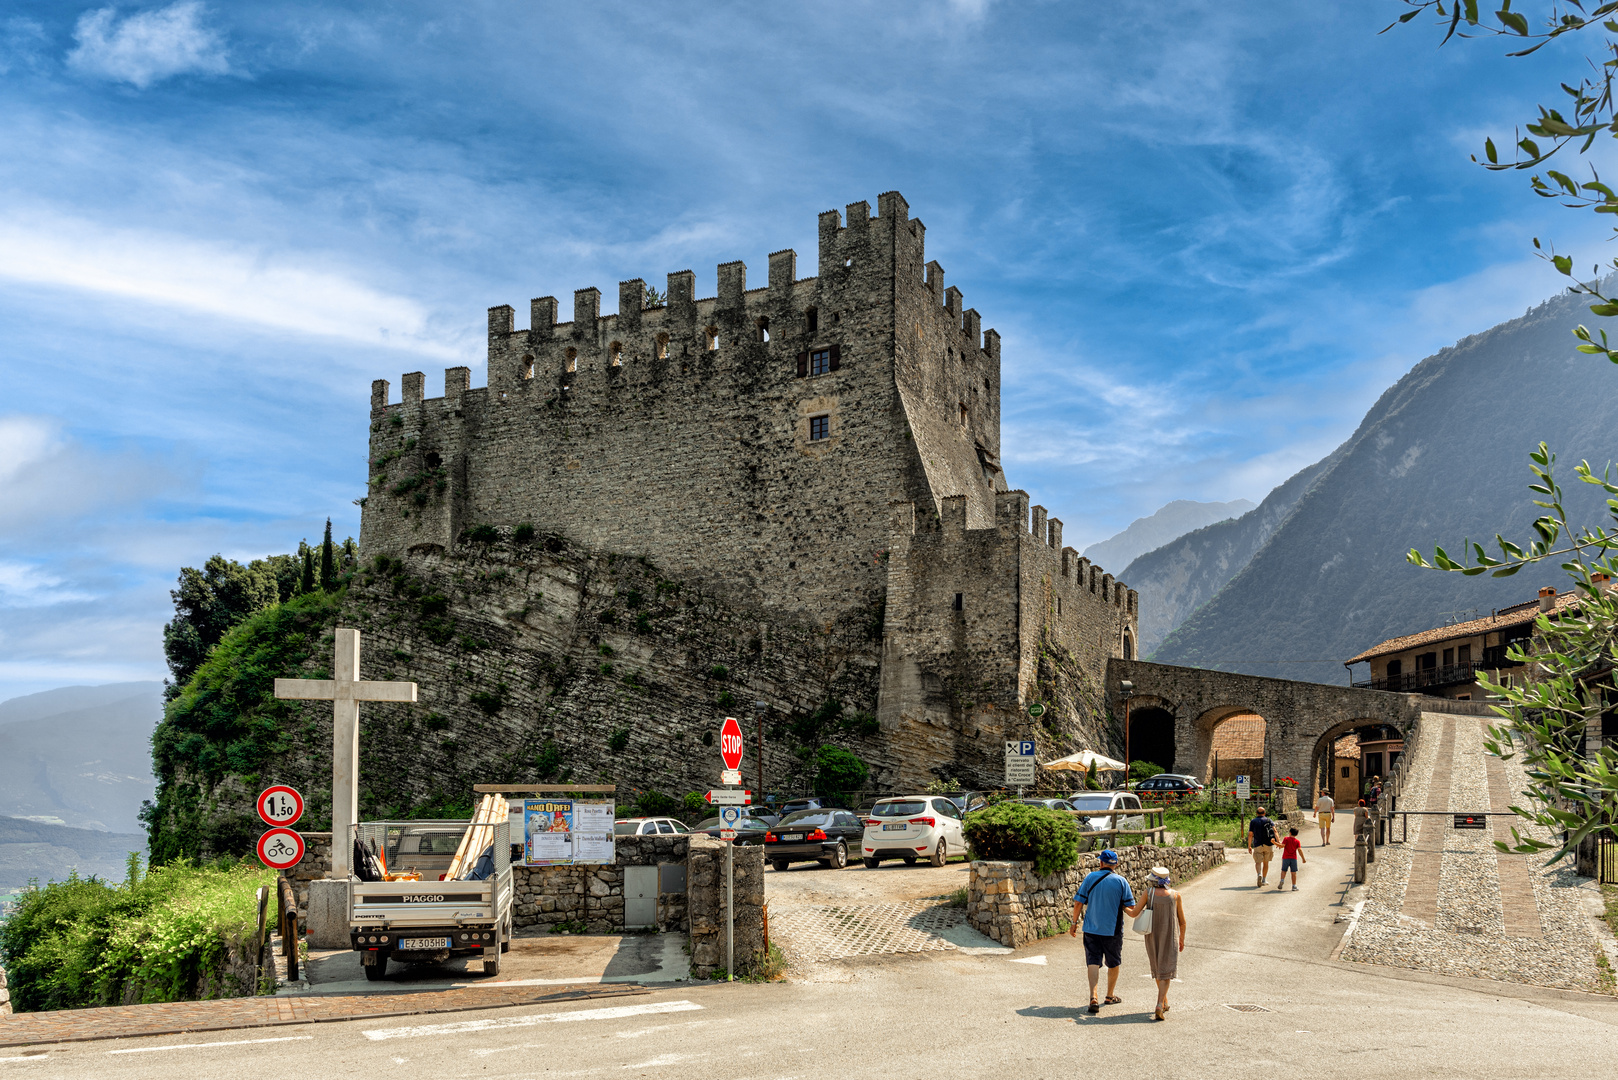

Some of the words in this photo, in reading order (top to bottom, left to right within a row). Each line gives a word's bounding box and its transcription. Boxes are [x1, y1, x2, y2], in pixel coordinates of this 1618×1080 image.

[722, 734, 742, 754] STOP
[1022, 742, 1032, 754] P
[406, 940, 416, 948] EZ
[418, 938, 446, 948] 303HB
